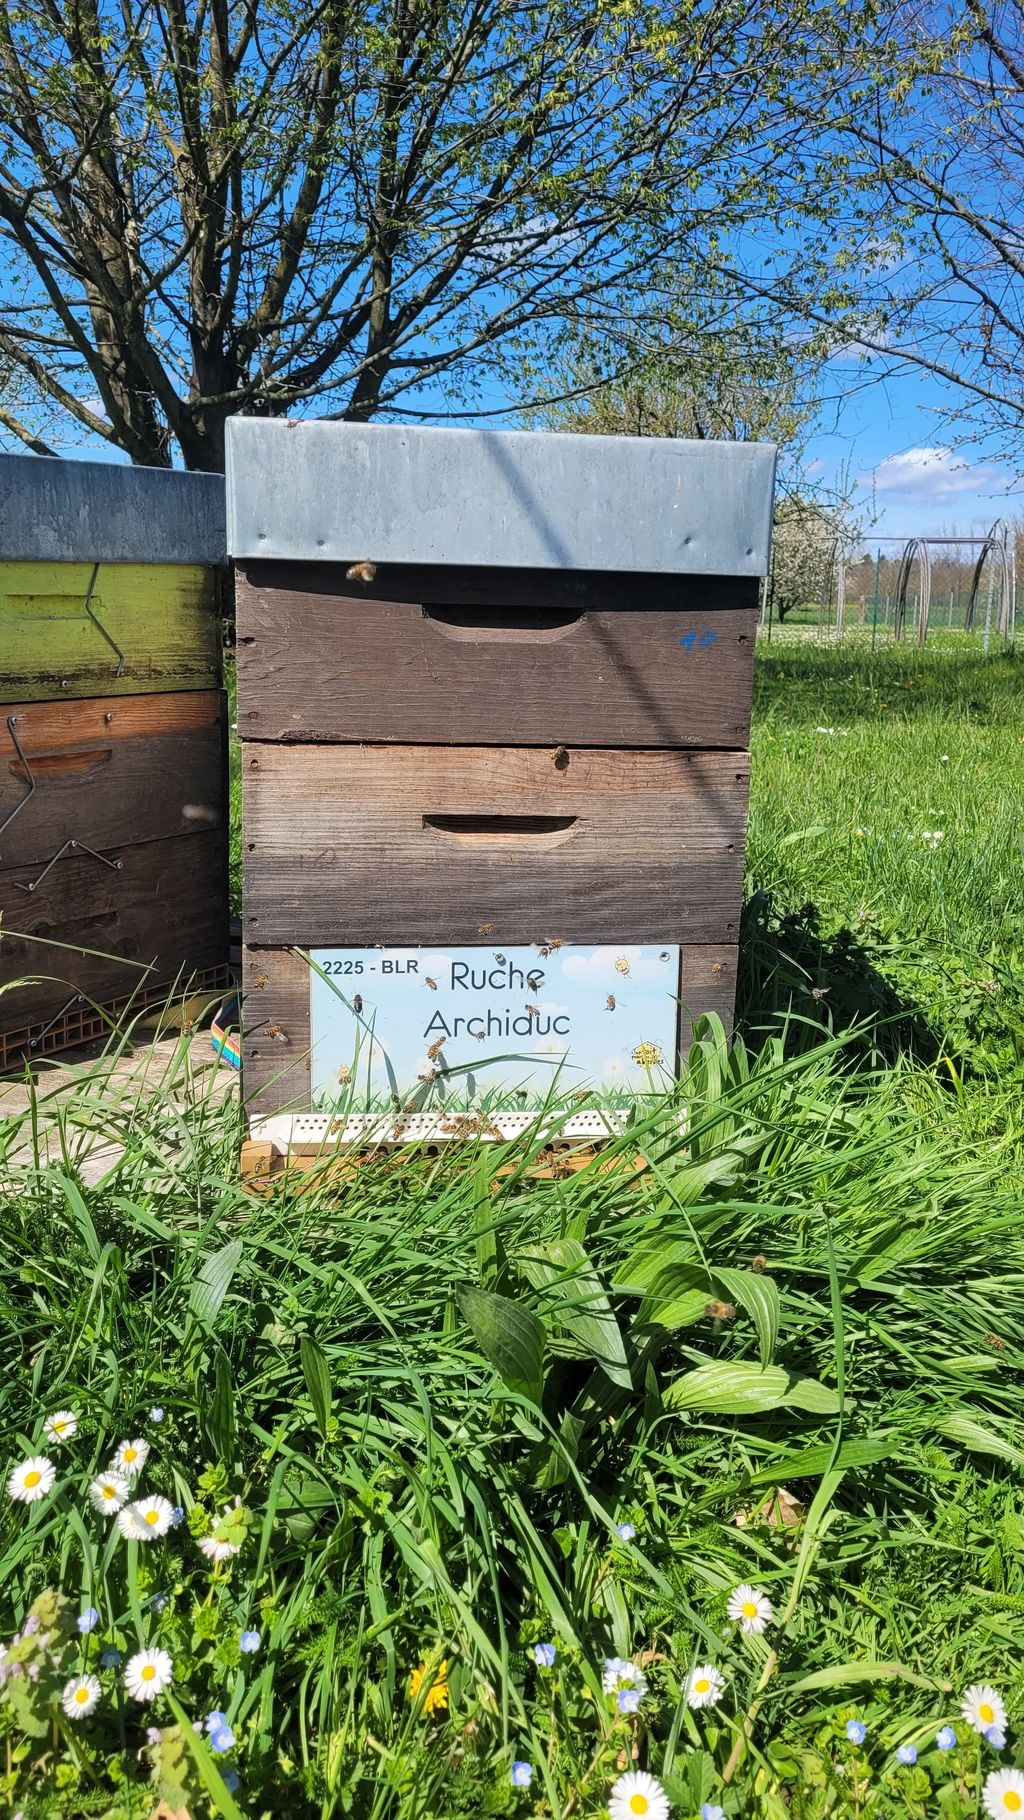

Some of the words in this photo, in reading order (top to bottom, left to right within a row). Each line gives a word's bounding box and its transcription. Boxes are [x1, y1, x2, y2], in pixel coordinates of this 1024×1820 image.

[322, 960, 365, 975] 2225
[381, 959, 420, 974] BLR
[451, 960, 546, 991] Ruche
[423, 1008, 571, 1039] Archiduc
